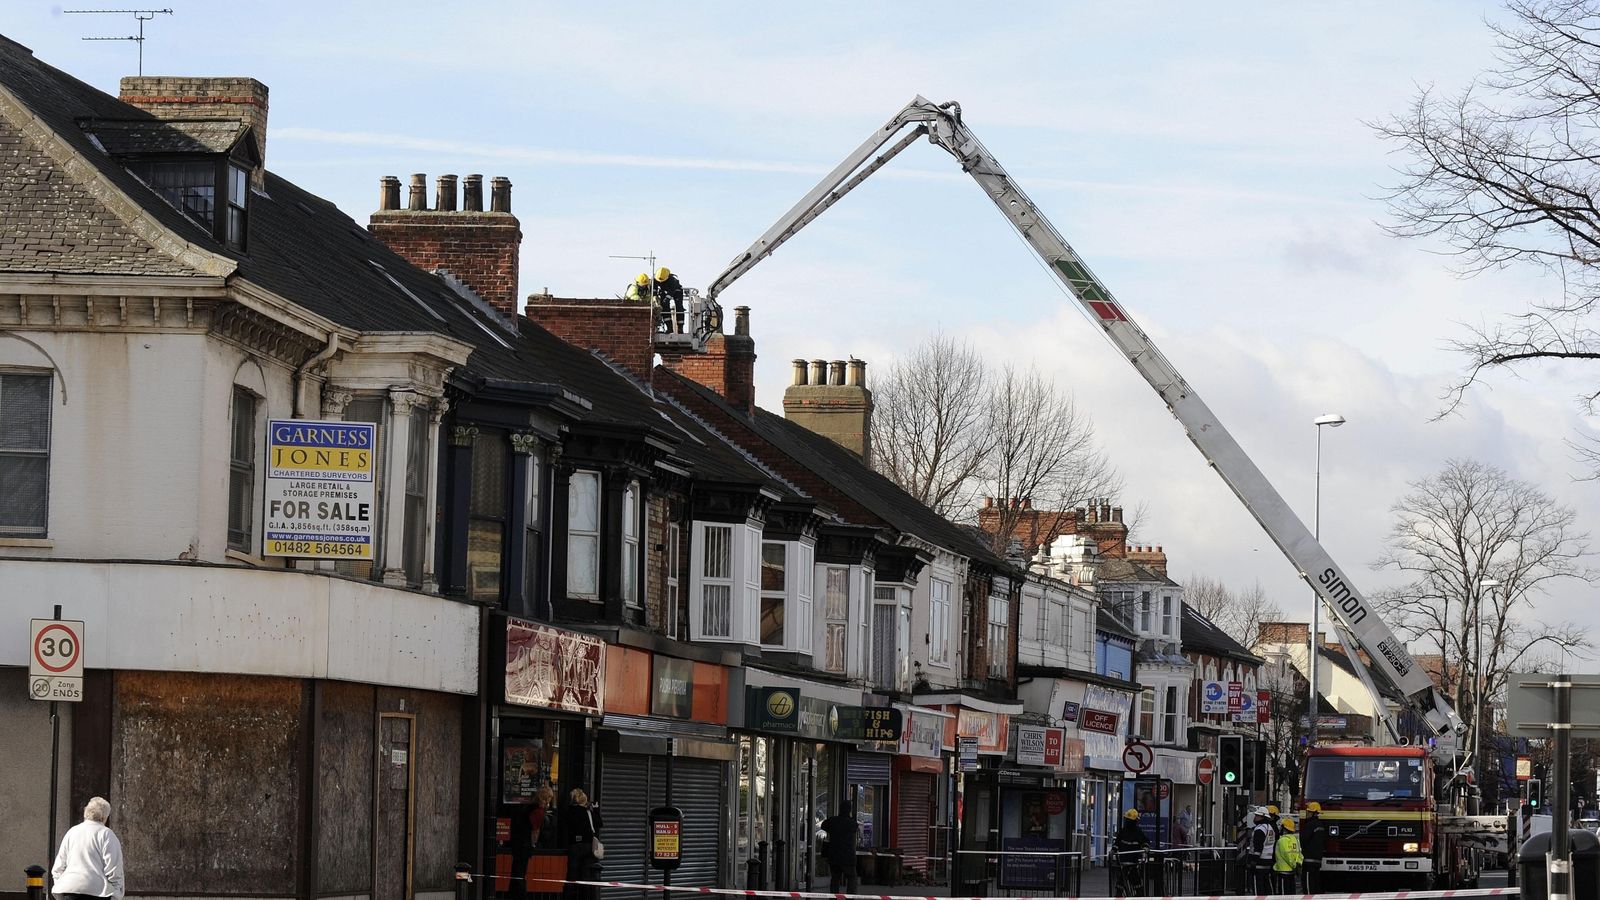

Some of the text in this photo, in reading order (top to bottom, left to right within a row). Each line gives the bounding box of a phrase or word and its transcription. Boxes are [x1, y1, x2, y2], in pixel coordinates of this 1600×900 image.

[276, 426, 368, 446] GARNESS
[276, 448, 367, 468] JONES
[274, 470, 320, 478] CHARTERED
[270, 500, 370, 521] FOR SALE
[272, 532, 366, 542] www.garnessjones.co.uk
[274, 542, 362, 555] 01482 564564
[42, 638, 73, 657] 30
[35, 684, 48, 692] 20
[53, 689, 80, 697] ENDS
[864, 710, 890, 720] FISH
[762, 720, 796, 729] pharmacy
[872, 719, 880, 728] &
[1086, 720, 1113, 730] LICENCE
[866, 728, 894, 738] HIPS
